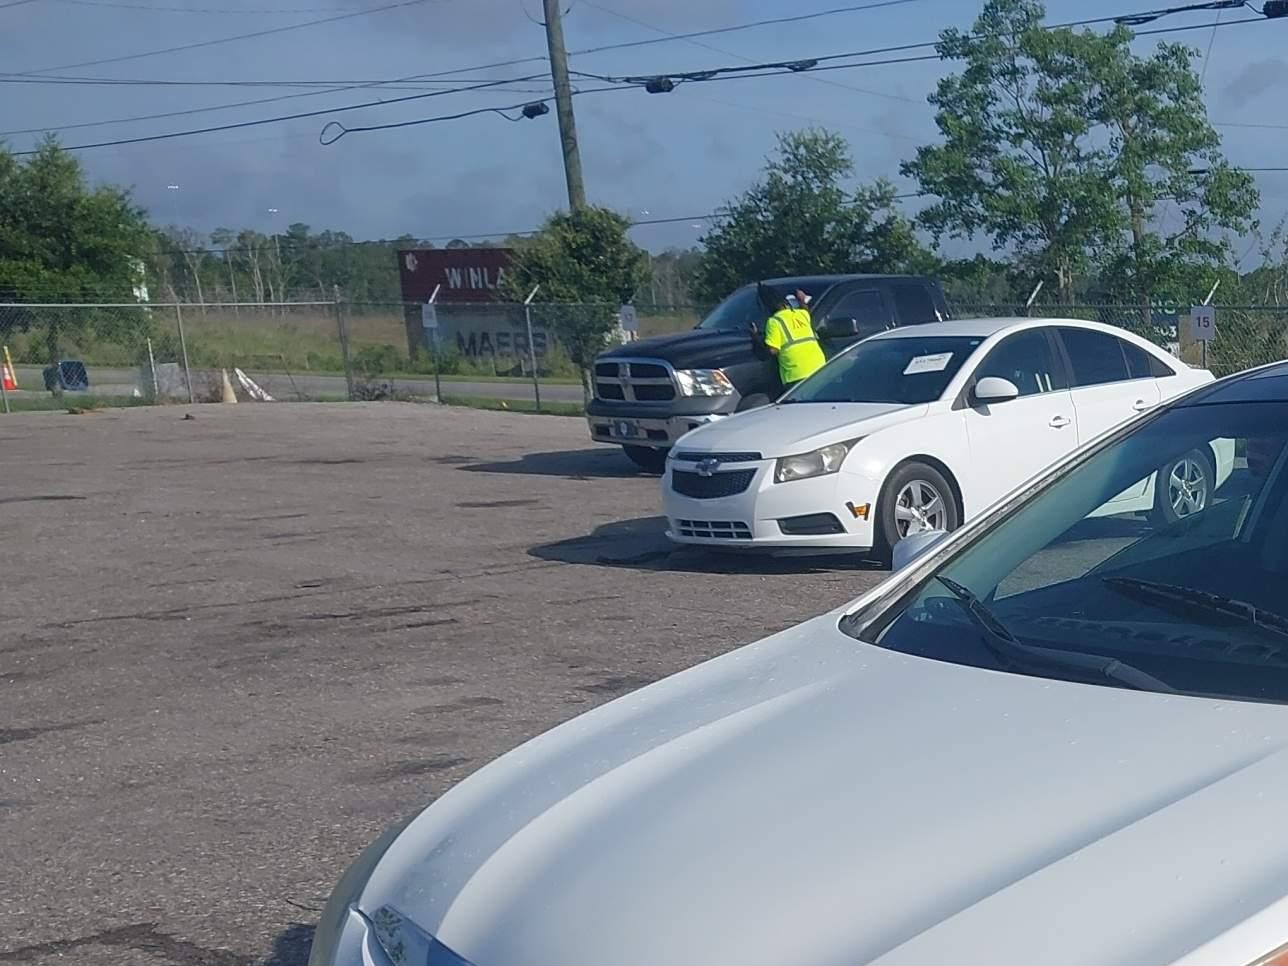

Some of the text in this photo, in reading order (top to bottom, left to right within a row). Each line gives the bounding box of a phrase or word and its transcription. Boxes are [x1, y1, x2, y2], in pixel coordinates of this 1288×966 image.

[444, 267, 505, 289] WINLA
[1196, 316, 1210, 328] 15
[456, 331, 546, 356] MAERS
